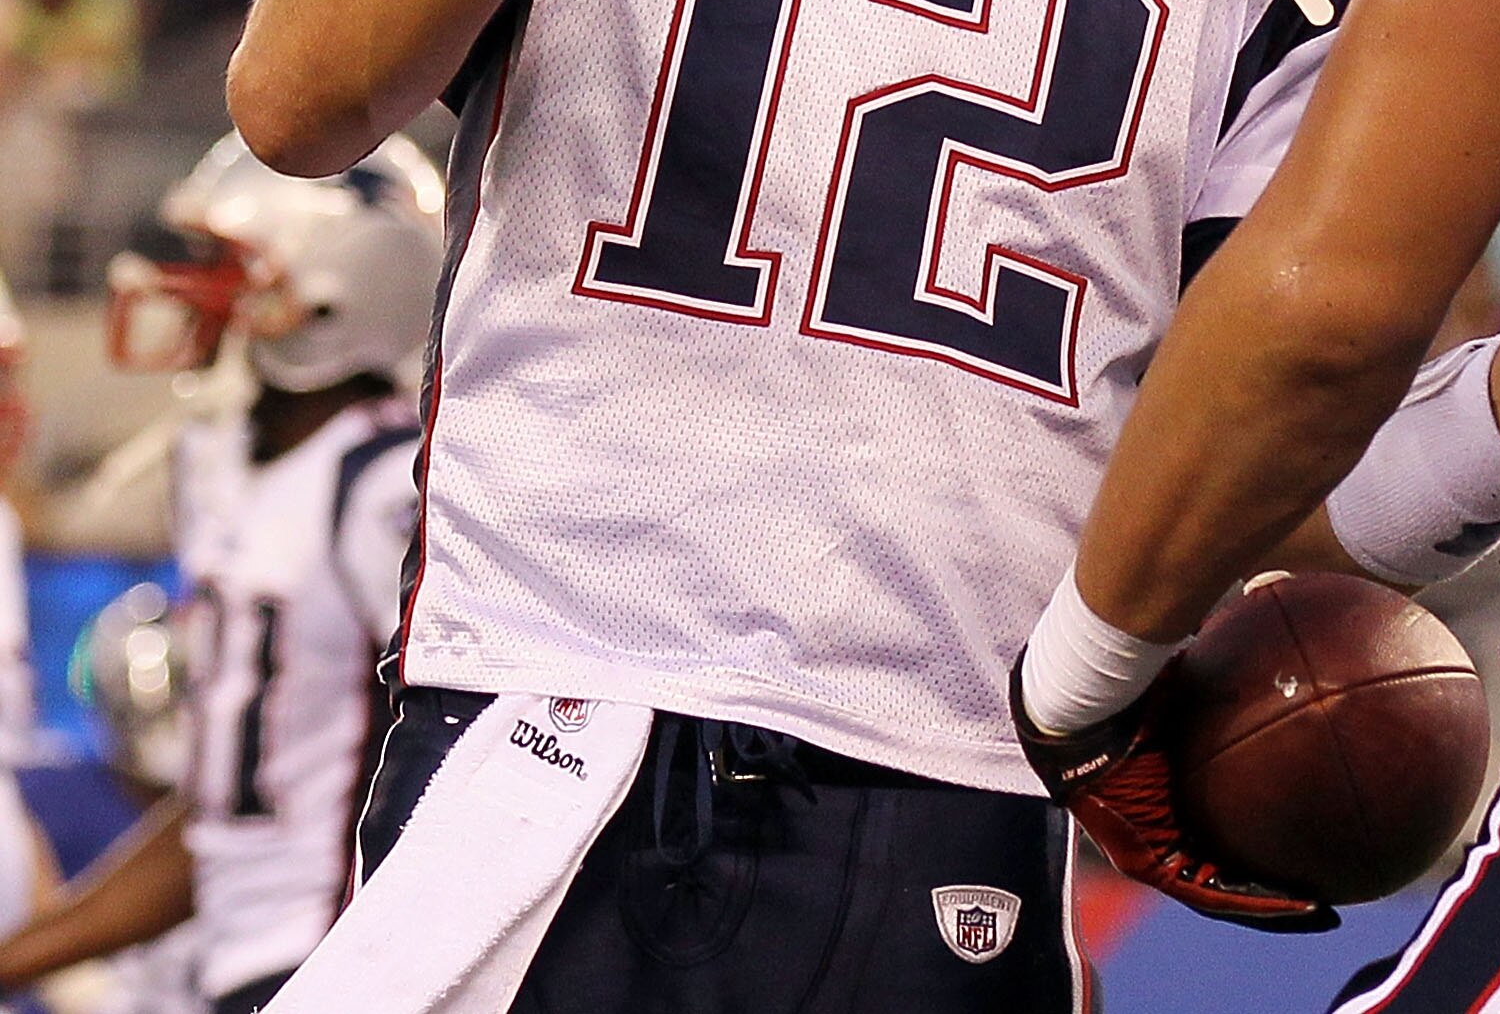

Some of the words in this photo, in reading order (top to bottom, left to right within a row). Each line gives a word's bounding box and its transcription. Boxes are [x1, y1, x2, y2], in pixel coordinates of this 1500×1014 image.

[555, 698, 585, 722] NFL
[509, 719, 587, 778] Wilson
[941, 891, 1013, 912] EQUIPMENT
[960, 925, 995, 948] NFL
